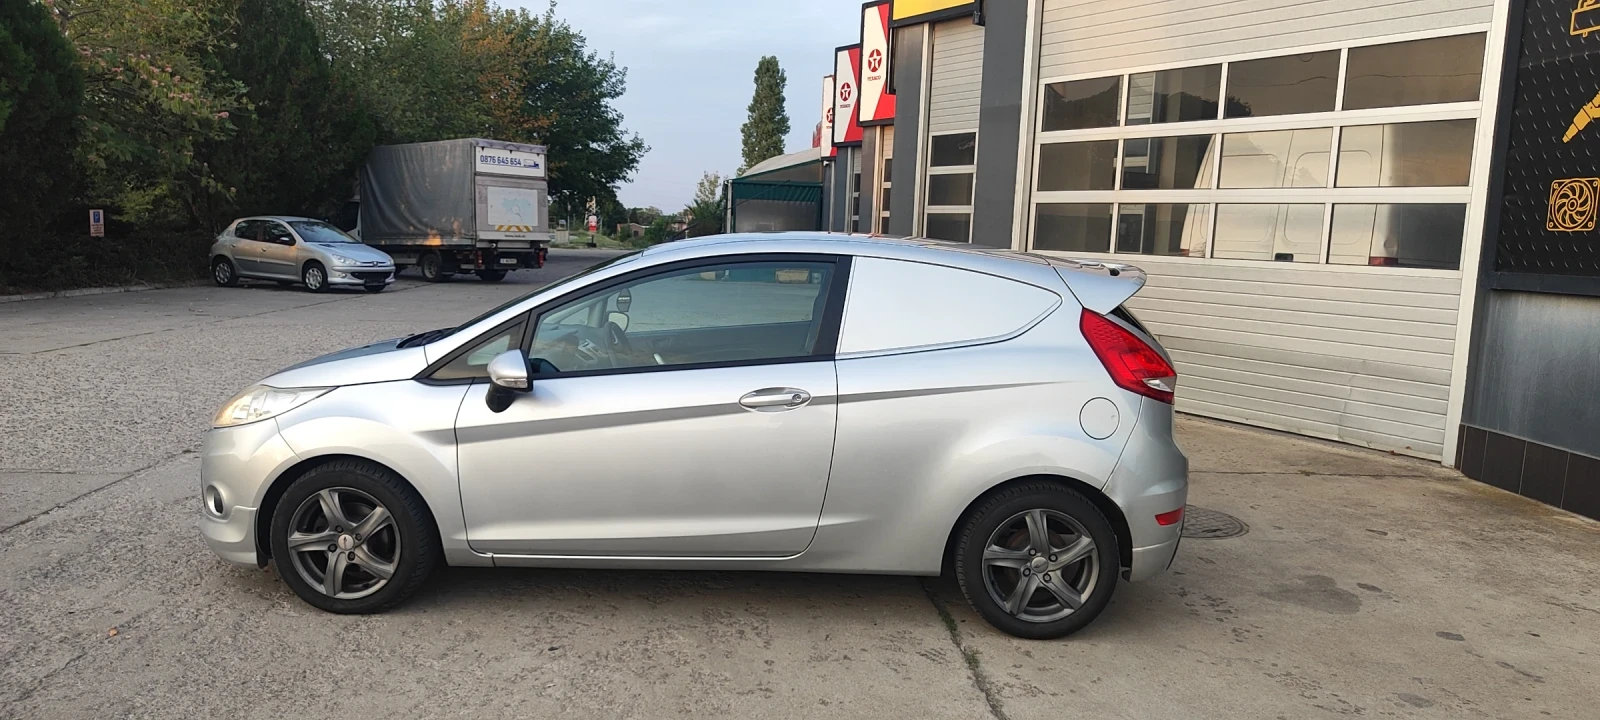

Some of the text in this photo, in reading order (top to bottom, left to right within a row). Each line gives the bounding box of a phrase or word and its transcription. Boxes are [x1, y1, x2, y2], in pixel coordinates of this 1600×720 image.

[480, 154, 522, 166] 0876 645 654
